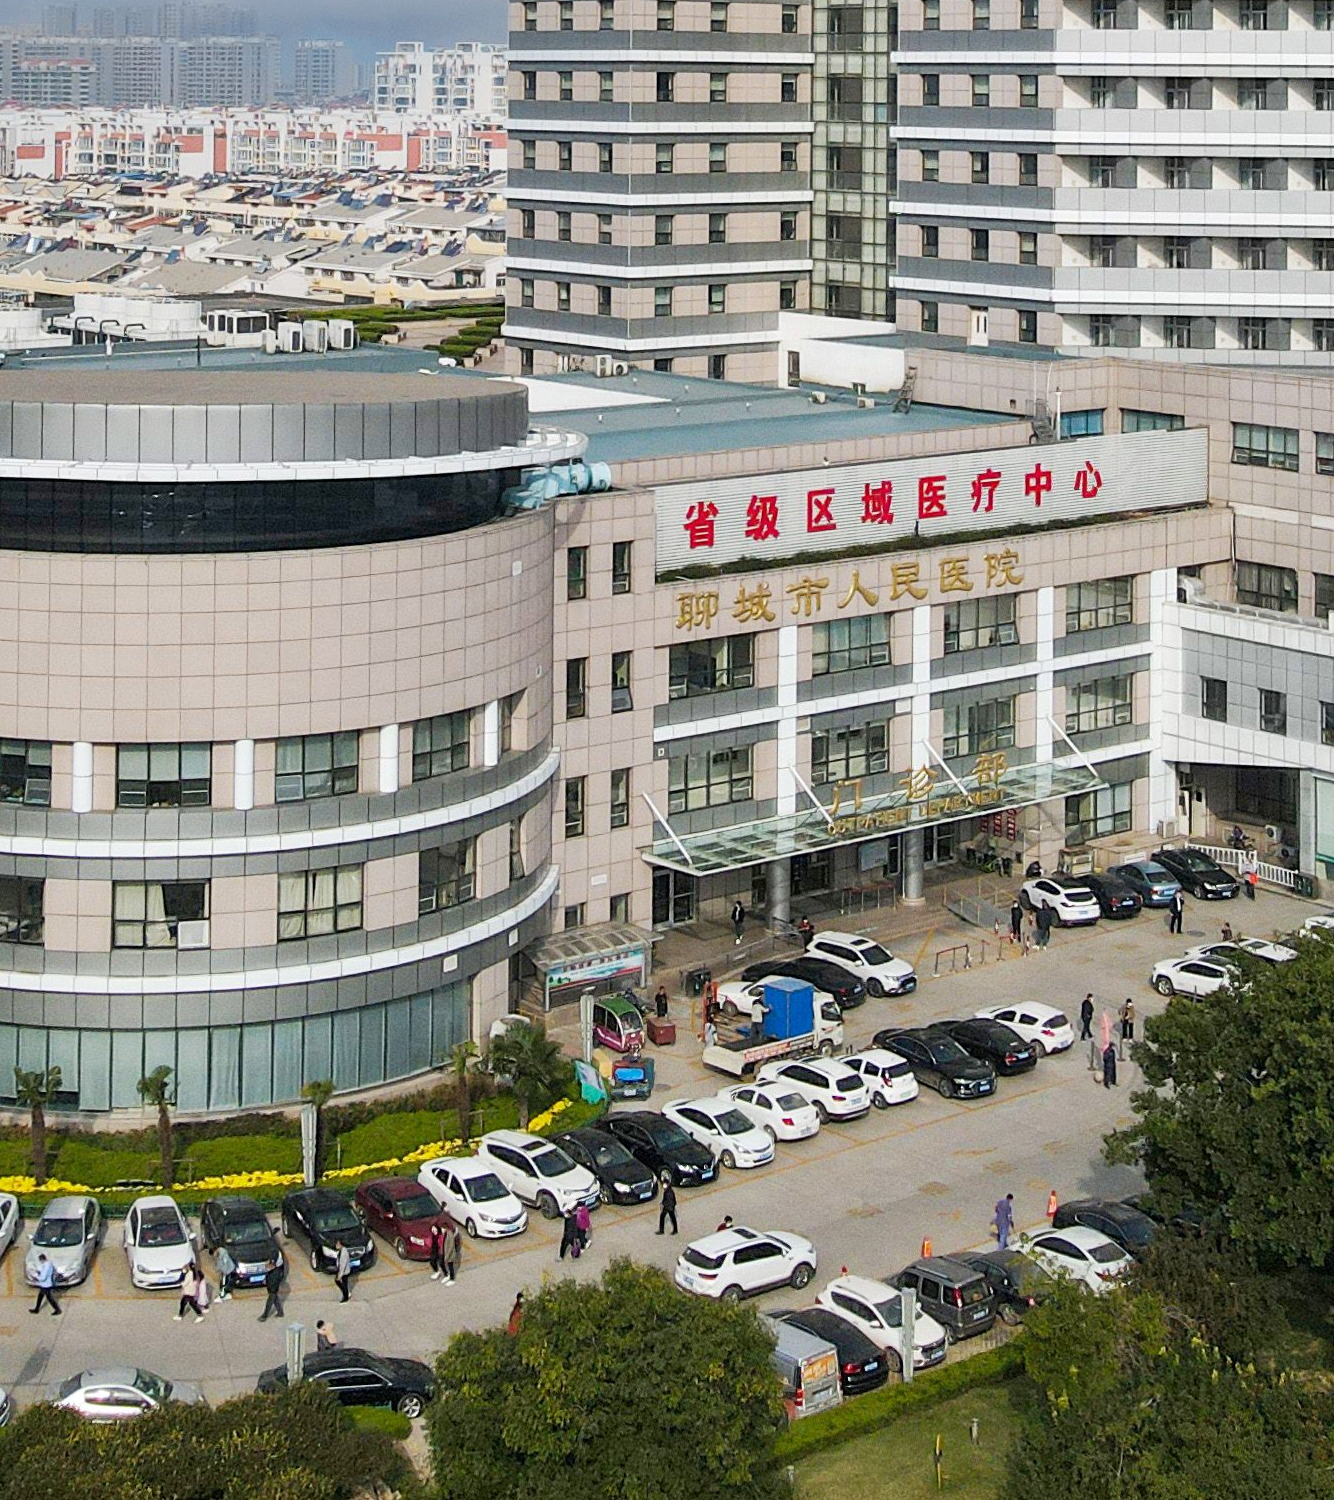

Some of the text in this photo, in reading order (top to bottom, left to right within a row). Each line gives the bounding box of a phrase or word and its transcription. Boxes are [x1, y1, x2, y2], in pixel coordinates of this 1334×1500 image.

[683, 459, 1104, 550] 省级区域医疗中心
[675, 547, 1025, 631] 聊城市人民医院
[828, 752, 1009, 818] 门诊部
